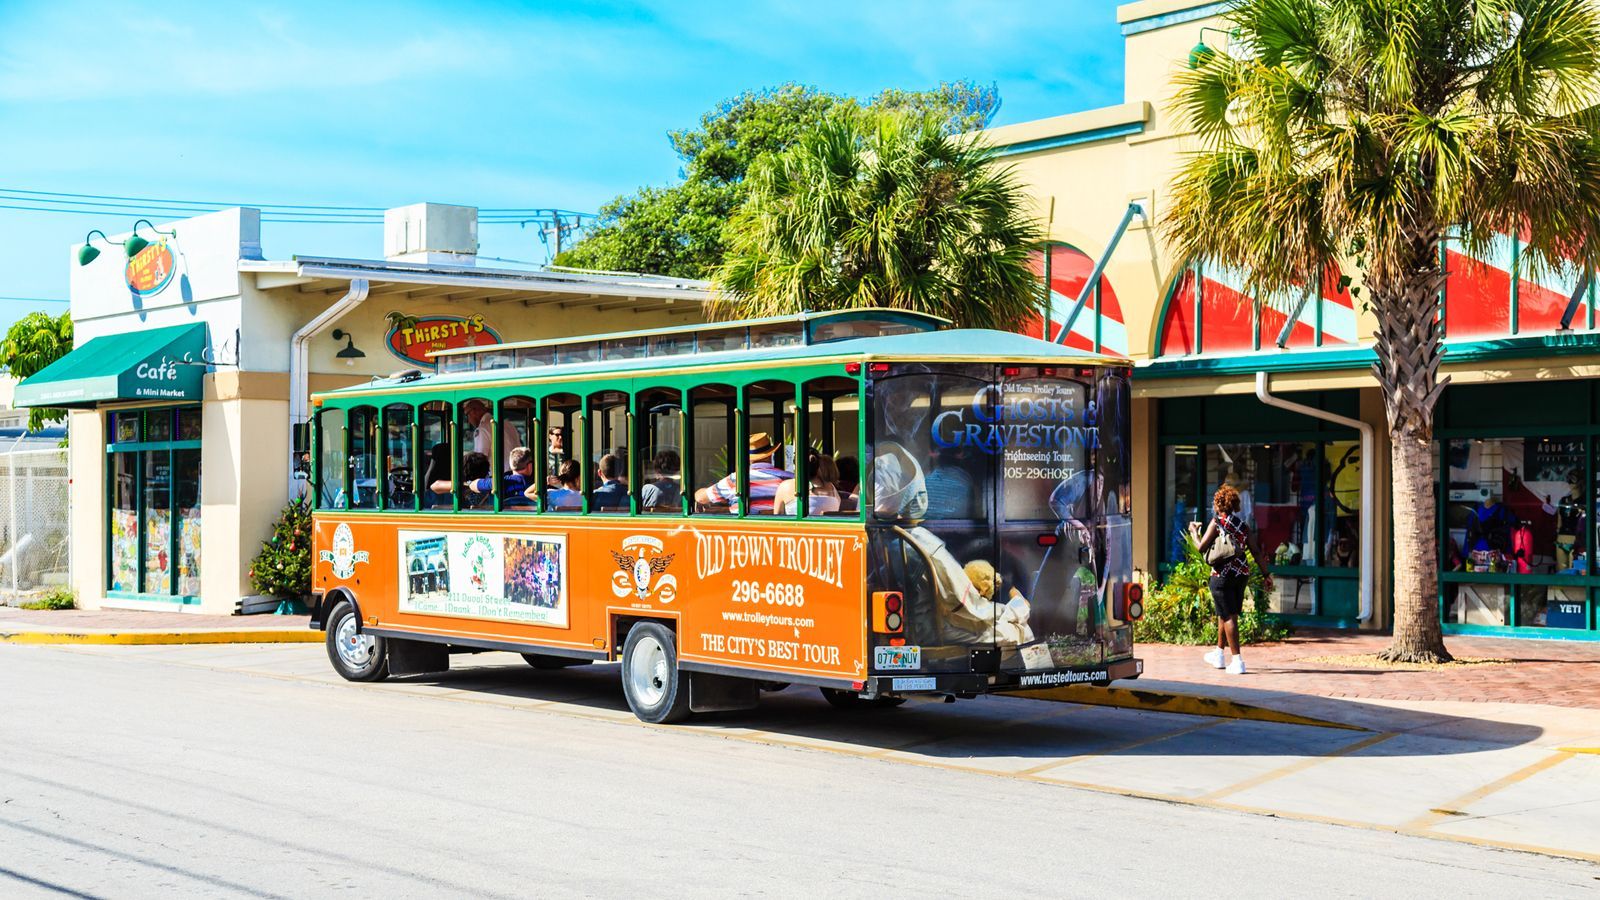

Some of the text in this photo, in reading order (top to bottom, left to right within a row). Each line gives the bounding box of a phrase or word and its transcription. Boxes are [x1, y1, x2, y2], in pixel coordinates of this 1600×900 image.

[143, 388, 159, 396] Mini
[160, 389, 185, 397] Market
[1016, 384, 1032, 393] Town
[1034, 384, 1054, 396] Trolley
[972, 382, 1074, 422] GHOSTS
[696, 533, 845, 589] OLD TOWN TROLLEY
[732, 580, 804, 607] 296-6688
[1560, 604, 1581, 614] YETI
[722, 610, 815, 628] www.trolleytours.com
[701, 633, 841, 666] THE CITY'S BEST TOUR
[1020, 670, 1107, 686] www.trustedtours.com
